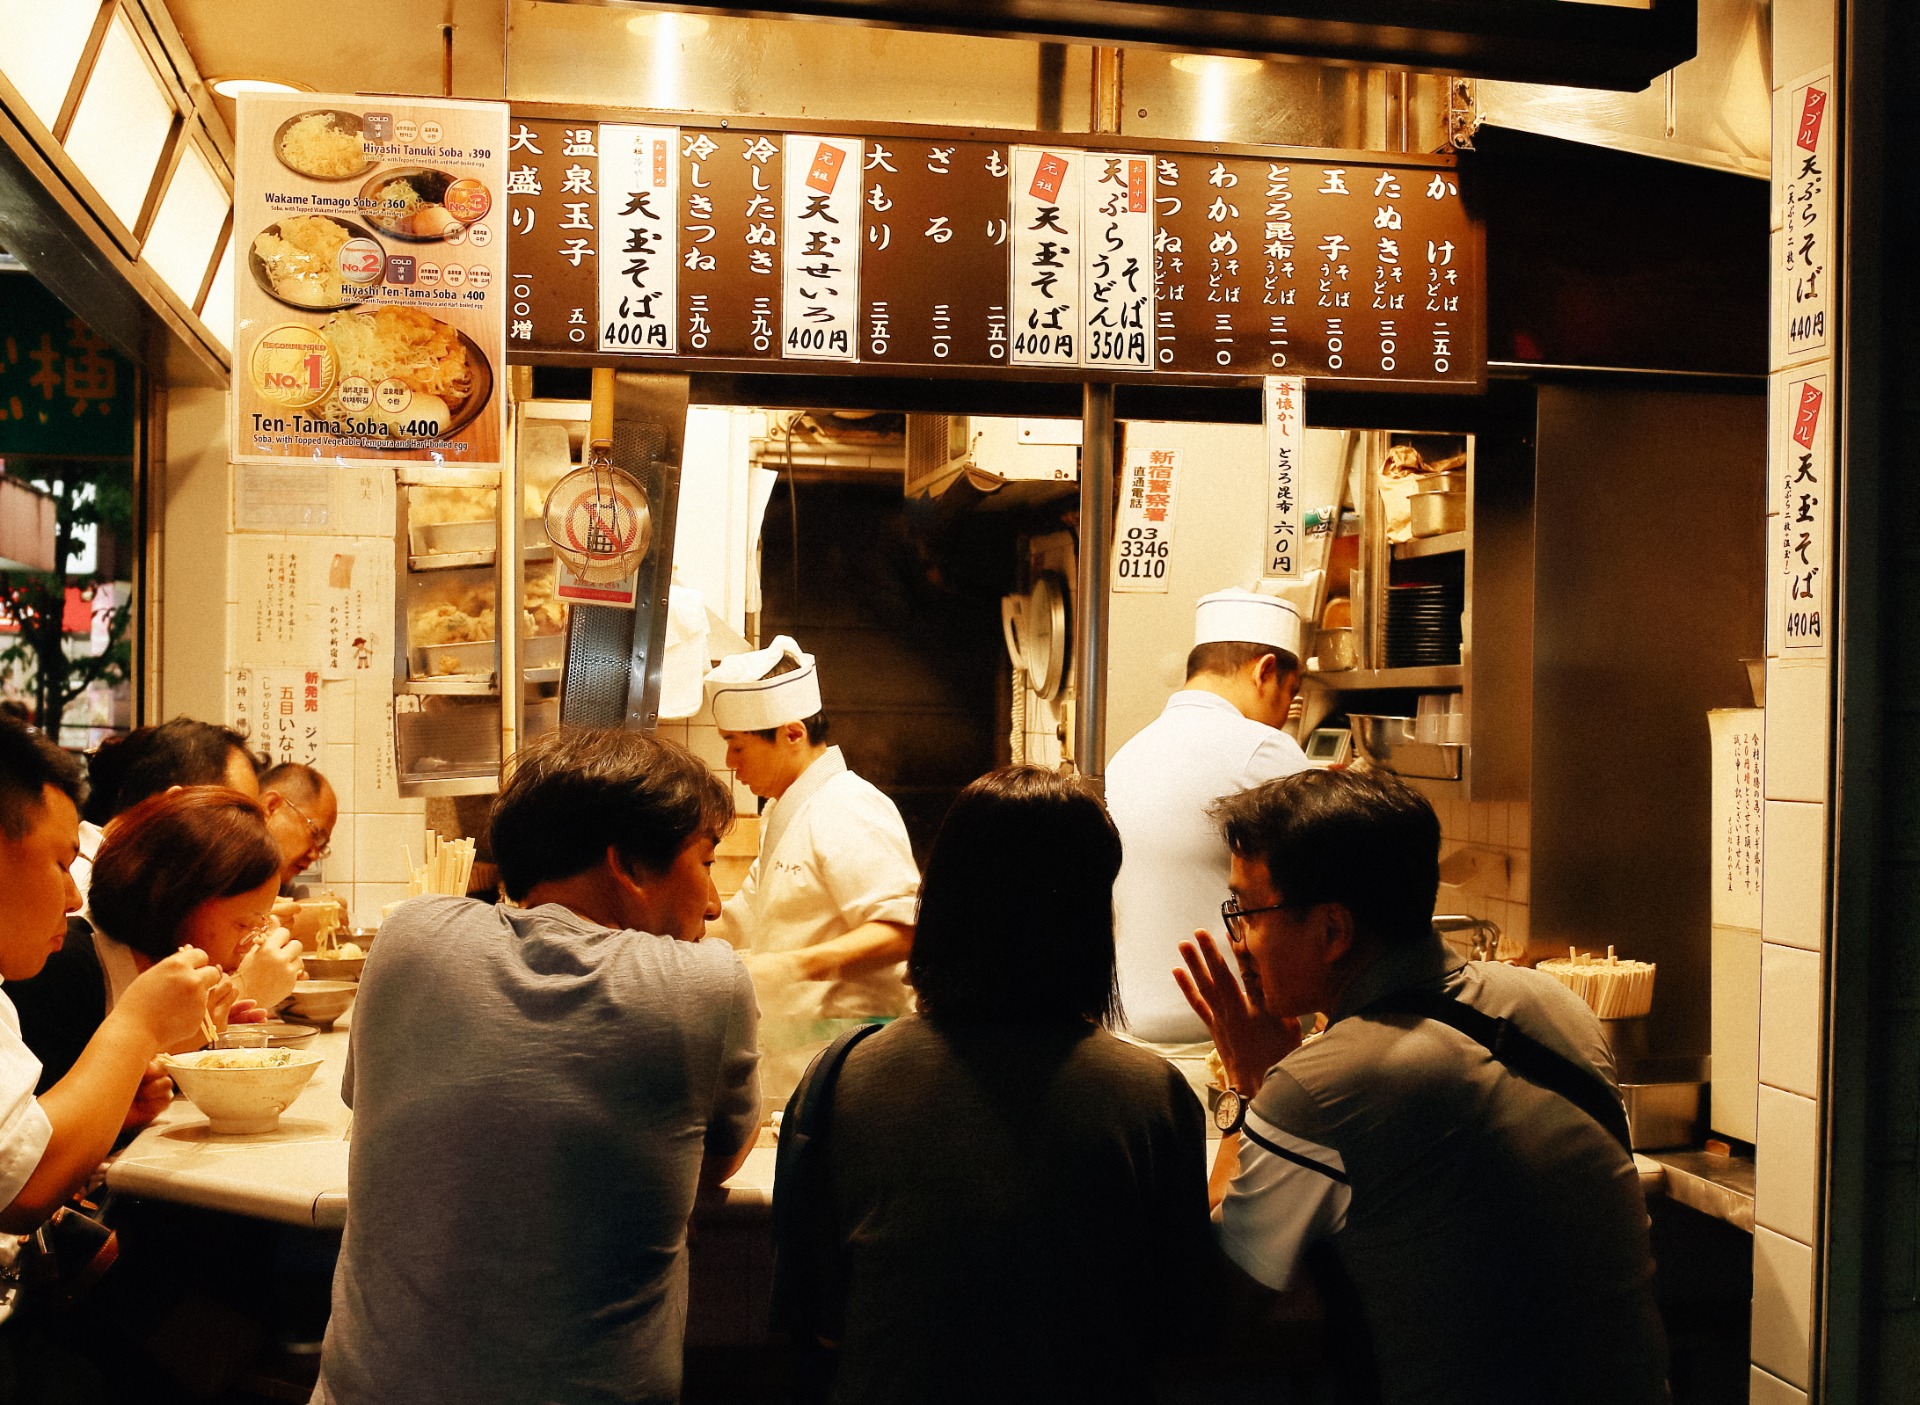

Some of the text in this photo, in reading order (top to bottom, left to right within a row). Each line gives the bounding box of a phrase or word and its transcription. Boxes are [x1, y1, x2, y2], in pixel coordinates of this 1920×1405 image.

[1801, 91, 1825, 145] ダブル
[363, 143, 491, 159] Hiyashi Tanuki Soba ¥390
[811, 150, 835, 183] 元祖
[1036, 161, 1060, 193] 元祖
[265, 192, 405, 209] Wakame Tamago Soba ¥360
[507, 124, 543, 236] 大盛り
[924, 147, 955, 243] ざる
[1131, 165, 1144, 211] おすすめ
[1154, 159, 1183, 253] きつね
[558, 128, 598, 343] 温泉玉子 五〇
[681, 134, 720, 350] 冷しきつね 三九〇
[742, 136, 780, 351] 冷したぬき 三九〇
[864, 143, 898, 355] 大もり 三五〇
[985, 150, 1009, 359] もり 二五〇
[1088, 158, 1148, 330] 天ぷら うどん そば
[1797, 155, 1823, 303] 天ぷらそば
[343, 255, 379, 272] No.2
[604, 191, 668, 348] 天玉そば 400円
[787, 195, 848, 353] 天玉せいろ 400円
[1014, 206, 1073, 358] 天玉そば 400円
[1168, 257, 1185, 301] そば
[1207, 162, 1241, 366] わかめ うどん そば 三一〇
[1263, 164, 1296, 368] とろろ昆布 うどん そば 三一〇
[1317, 169, 1351, 369] 玉子 うどん そば 三〇〇
[1372, 171, 1405, 372] たぬき うどん そば 三〇〇
[1425, 173, 1459, 373] かけ うどん そば 二五〇
[341, 285, 485, 300] Hiyashi Ten-Tama Soba ¥400
[1090, 332, 1145, 363] 350円
[1157, 312, 1176, 364] 三一〇
[1790, 311, 1825, 342] 440円
[264, 354, 322, 389] No.1
[252, 414, 439, 436] Ten-Tama Soba ¥400
[1275, 383, 1295, 436] 昔懐かし
[1796, 390, 1821, 440] ダブル
[253, 434, 274, 444] Soba,
[275, 435, 295, 443] with
[296, 435, 321, 446] Topped
[323, 436, 360, 447] Vegetable
[361, 438, 394, 449] Tempura
[395, 439, 410, 448] and
[454, 441, 468, 450] egg
[1130, 466, 1146, 509] 直通電話
[1143, 450, 1176, 522] 新宿警察署
[1276, 447, 1294, 514] とろろ昆布
[1121, 540, 1168, 557] 3346
[1127, 528, 1158, 539] 03
[1792, 453, 1819, 600] 天玉そば
[1119, 559, 1165, 578] 0110
[1787, 610, 1820, 638] 490円
[305, 671, 319, 712] 新発売
